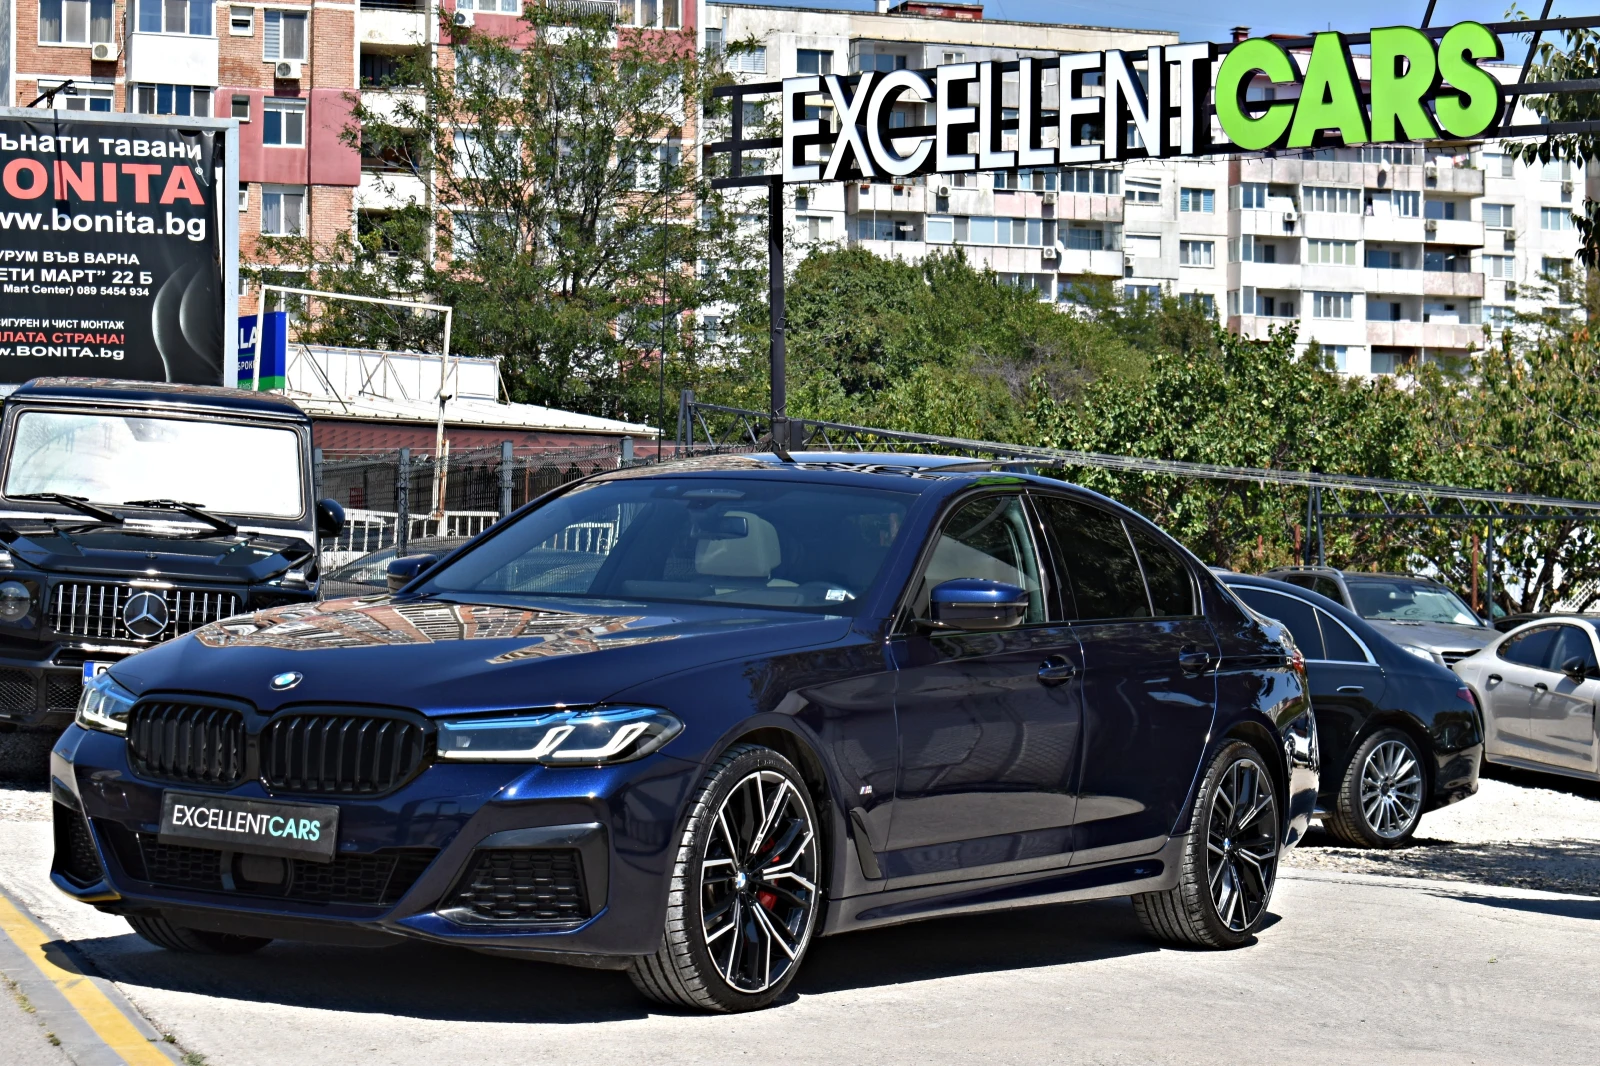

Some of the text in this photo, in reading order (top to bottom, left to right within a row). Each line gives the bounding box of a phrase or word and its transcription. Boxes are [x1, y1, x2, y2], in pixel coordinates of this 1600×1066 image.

[98, 138, 203, 160] тавани
[2, 157, 205, 205] ONITA
[43, 251, 79, 263] ВЪВ
[84, 252, 140, 265] ВАРНА
[112, 270, 134, 284] 22
[140, 271, 153, 285] Б
[3, 284, 150, 296] Mart Center) 089 5454 934
[0, 318, 125, 329] ИГУРЕН И ЧИСТ МОНТАЖ
[52, 332, 125, 344] СТРАНА!
